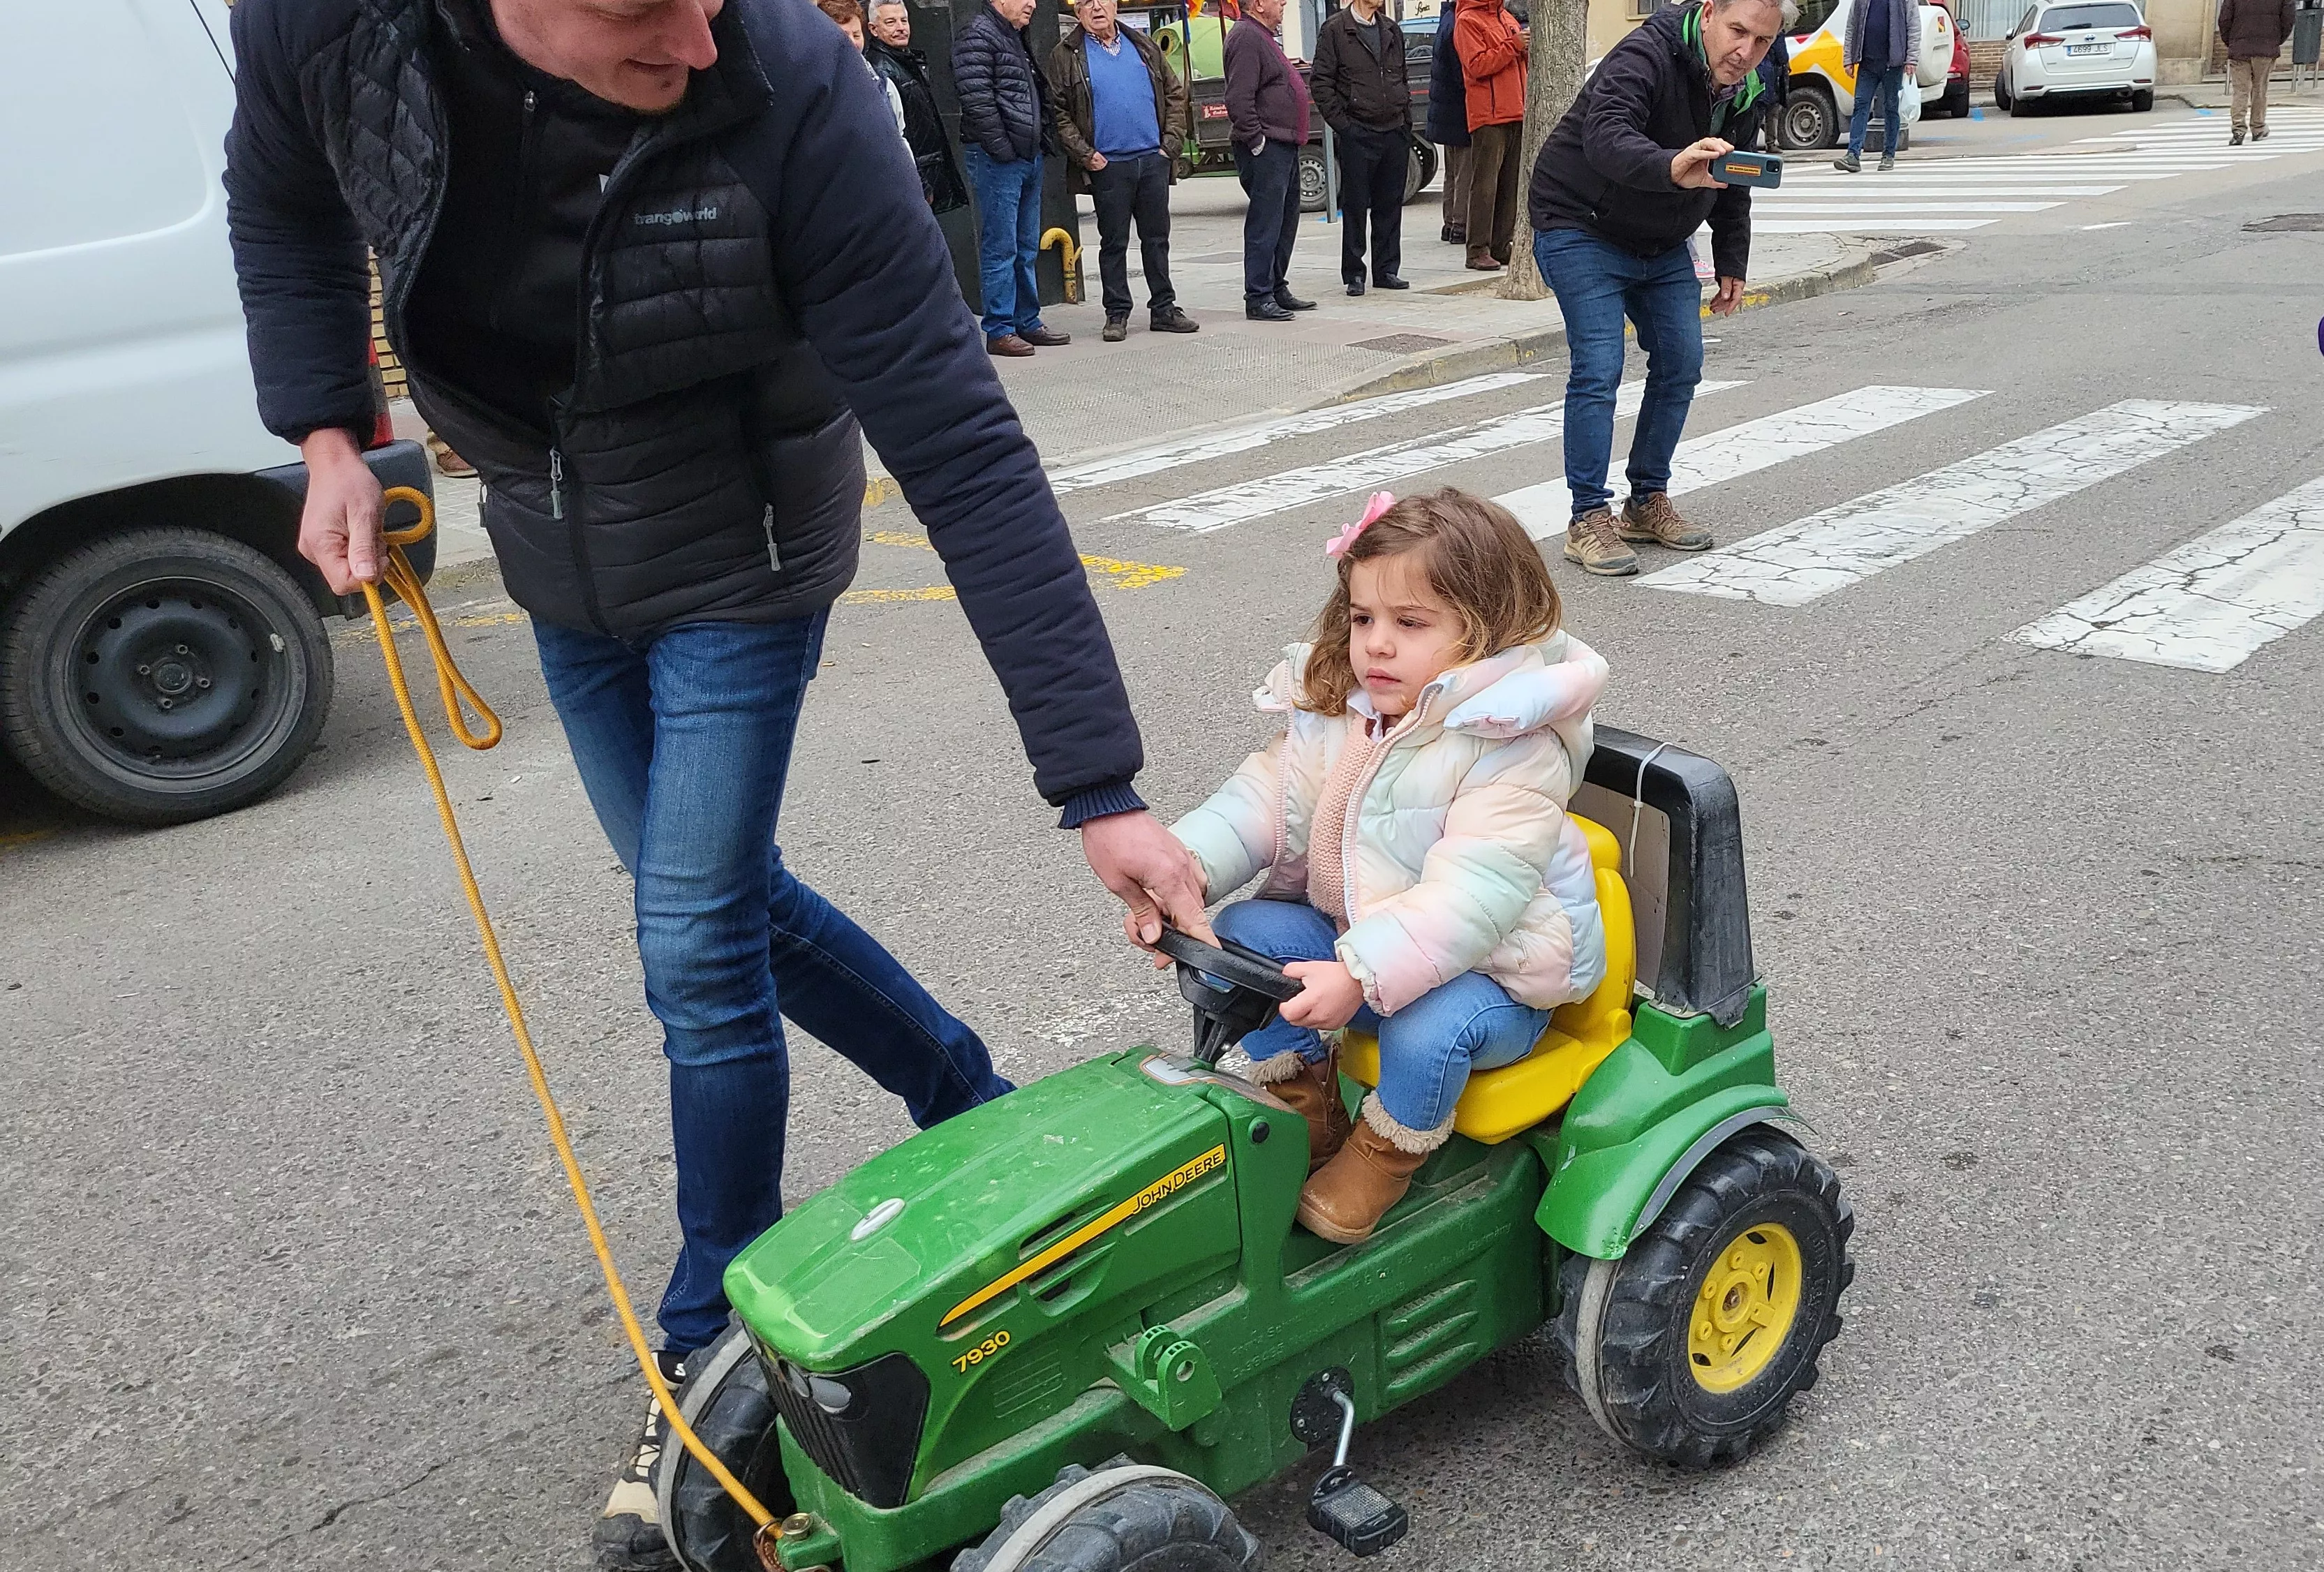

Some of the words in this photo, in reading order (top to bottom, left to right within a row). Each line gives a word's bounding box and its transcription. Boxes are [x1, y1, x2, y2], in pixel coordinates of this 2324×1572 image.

[1132, 1180, 1172, 1213] JOHN
[1174, 1151, 1221, 1190] DEERE
[952, 1330, 1011, 1373] 7930
